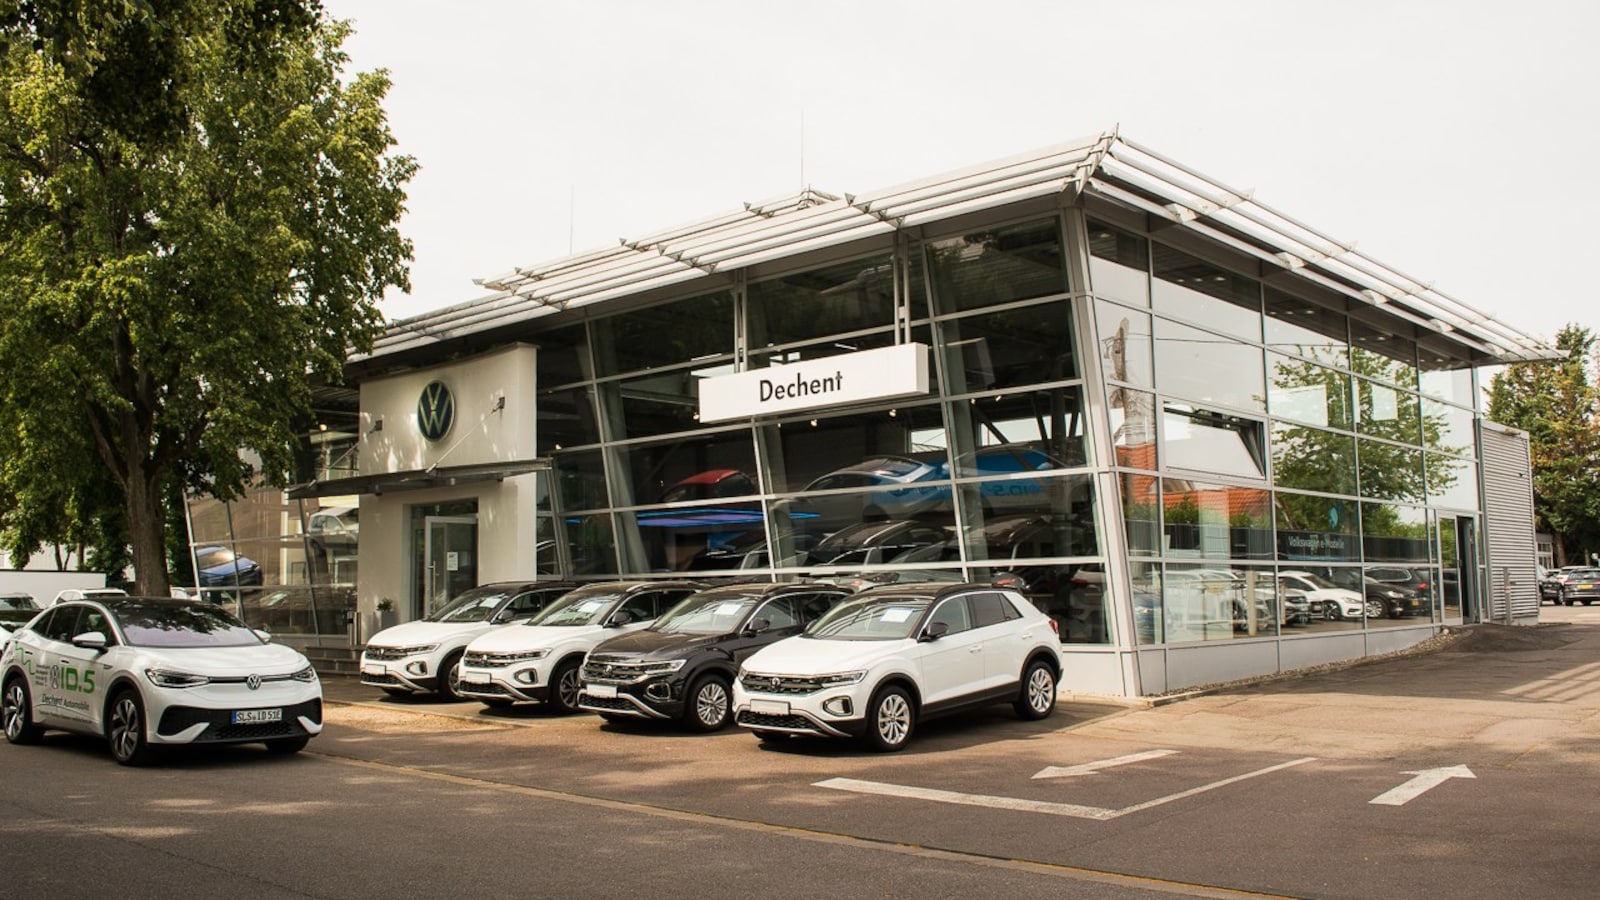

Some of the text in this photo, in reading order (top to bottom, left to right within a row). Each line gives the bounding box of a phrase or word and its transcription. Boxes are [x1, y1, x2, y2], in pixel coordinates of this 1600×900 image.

[759, 370, 843, 402] Dechent
[60, 667, 95, 693] ID.5
[236, 711, 252, 722] SLS
